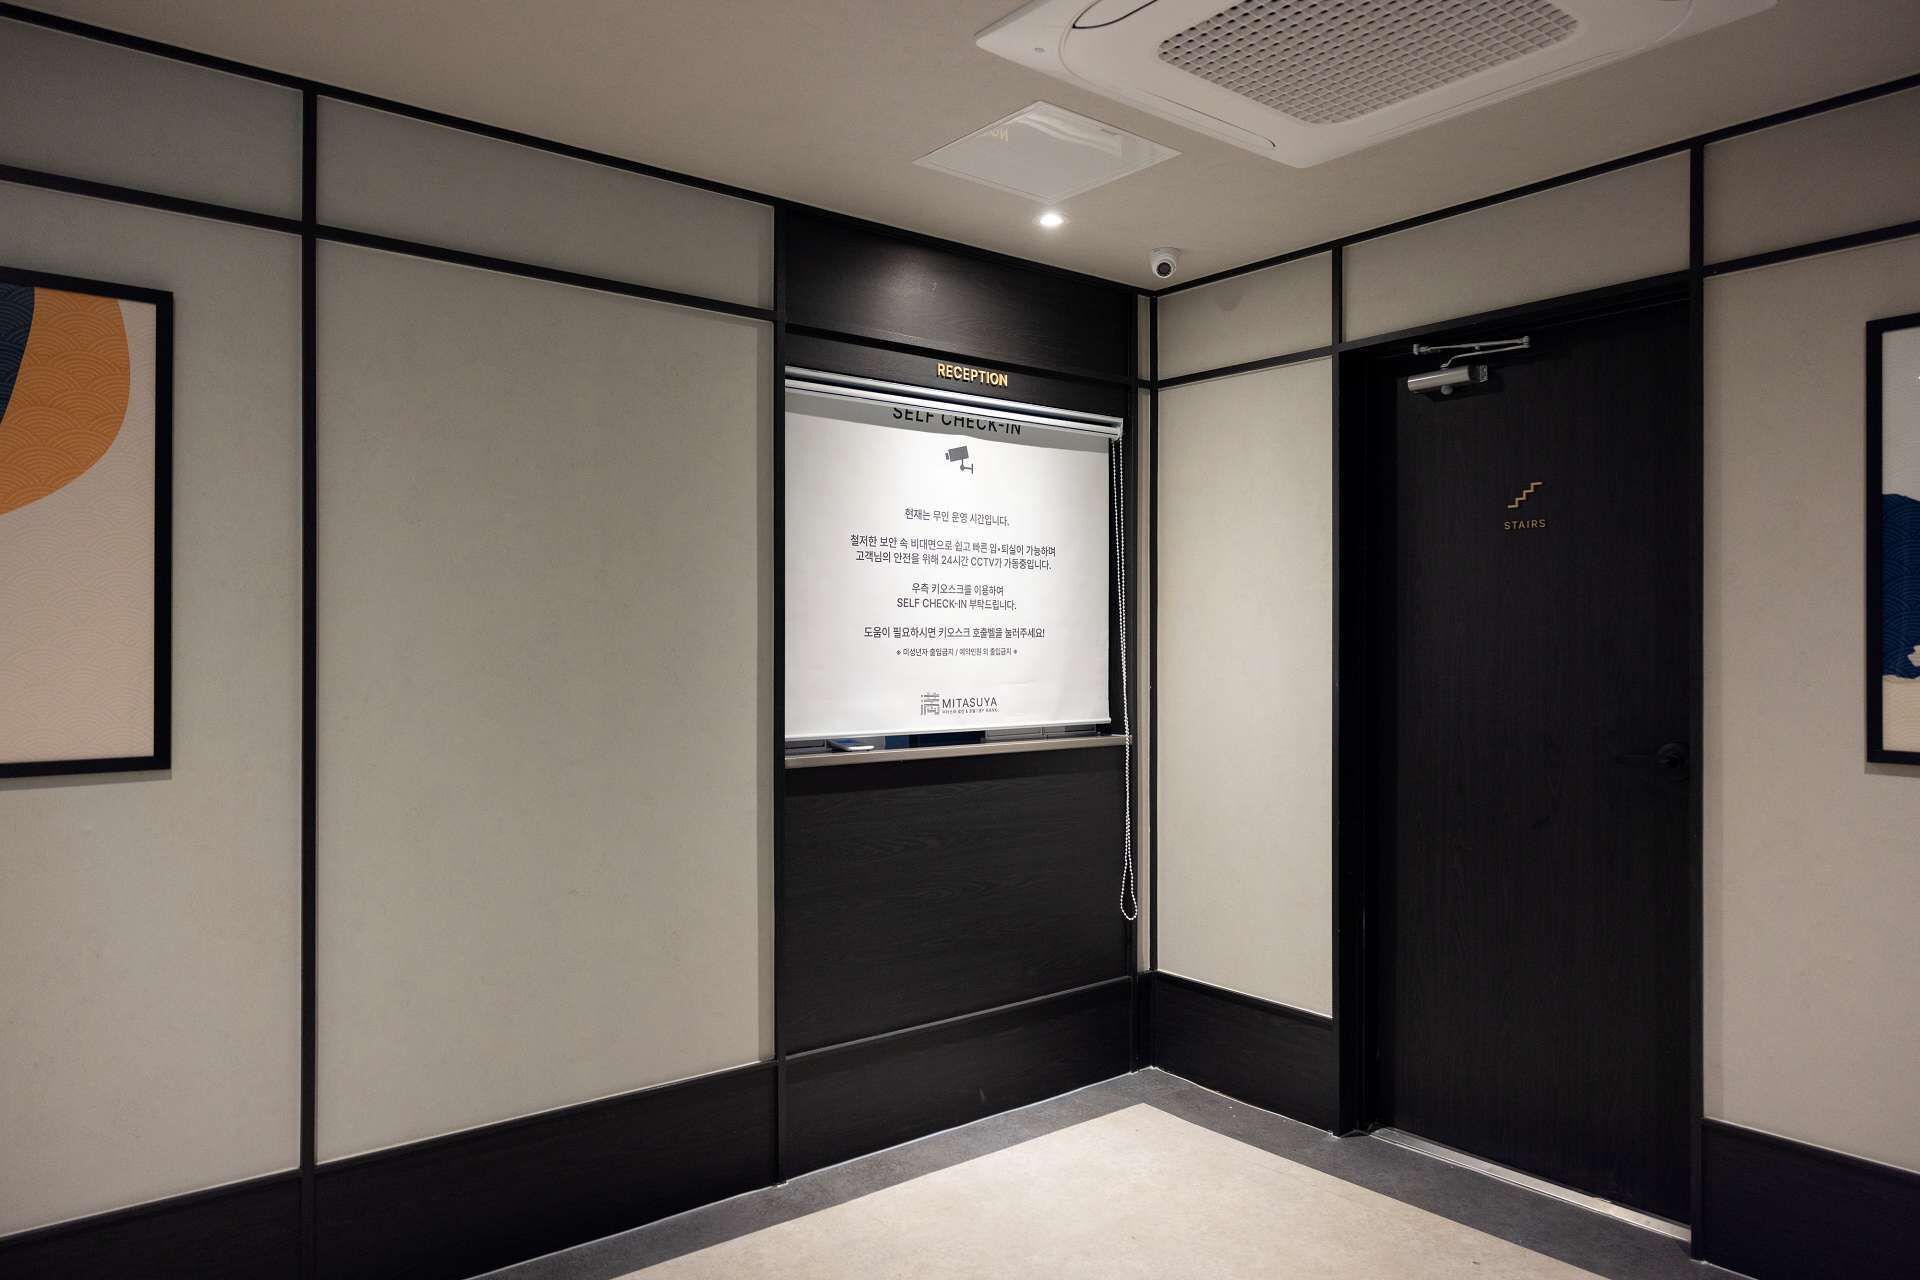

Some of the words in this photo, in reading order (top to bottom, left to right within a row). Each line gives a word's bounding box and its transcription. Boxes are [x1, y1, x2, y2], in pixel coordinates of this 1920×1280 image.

[937, 363, 1008, 388] RECEPTION
[904, 508, 930, 520] 현재는
[933, 510, 948, 522] 무인
[952, 512, 968, 524] 운영
[970, 513, 1010, 526] 시간입니다.
[1504, 519, 1546, 530] STAIRS
[850, 534, 877, 547] 철저한
[880, 536, 897, 548] 보안
[900, 538, 908, 550] 속
[911, 538, 952, 550] 비대면으로
[954, 540, 970, 552] 쉽고
[972, 542, 988, 554] 빠른
[1026, 545, 1056, 557] 가능하며
[856, 550, 891, 563] 고객님의
[894, 552, 920, 564] 안전을
[922, 554, 938, 565] 위해
[942, 555, 968, 566] 24시간
[970, 556, 1002, 568] CCTV가
[1004, 558, 1052, 570] 가동중입니다.
[912, 582, 929, 594] 우측
[931, 583, 972, 596] 키오스크를
[974, 584, 1004, 596] 이용하며
[896, 598, 920, 608] SELF
[922, 598, 968, 608] CHECK-IN
[969, 599, 1017, 610] 부탁드립니다.
[864, 626, 890, 638] 도움이
[893, 626, 936, 638] 필요하시면
[938, 626, 970, 638] 키오스크
[972, 627, 1003, 639] 호출벨을
[1005, 627, 1045, 639] 눌러주세요!
[902, 648, 928, 656] 미성년자
[930, 648, 954, 656] 출입금지
[942, 696, 998, 709] MITASUYA
